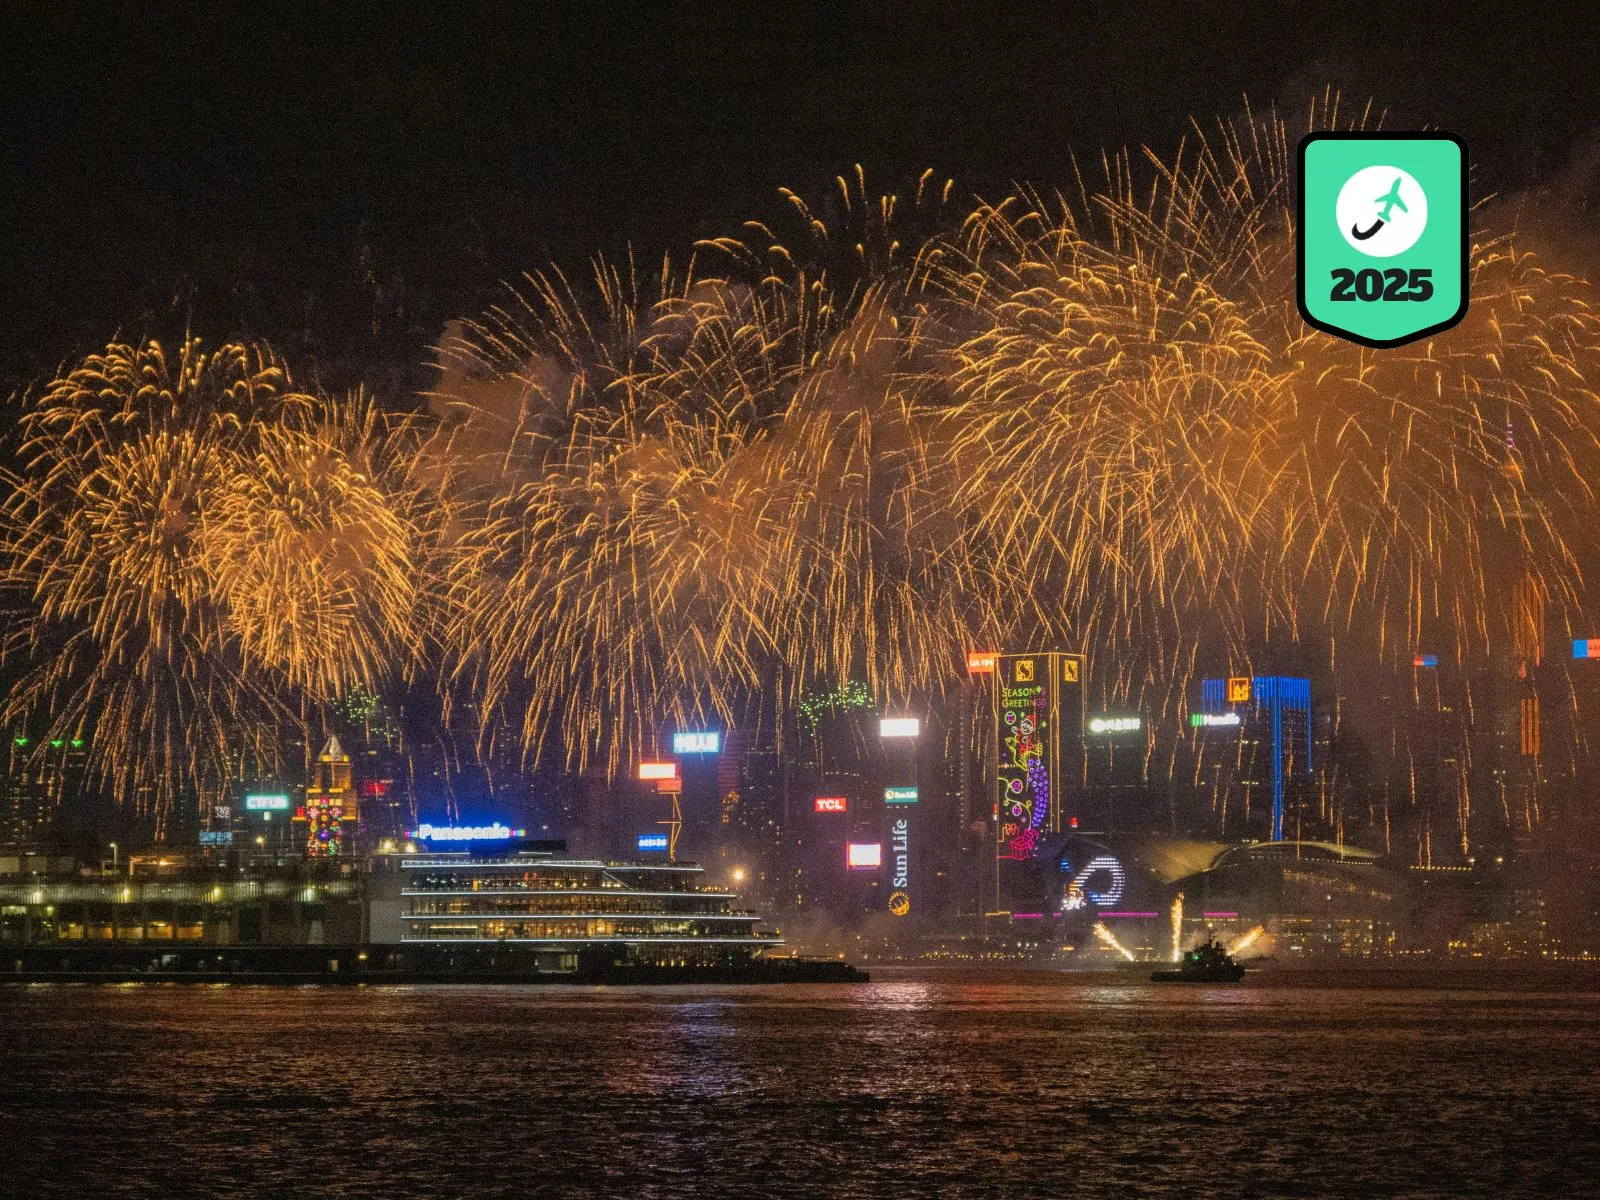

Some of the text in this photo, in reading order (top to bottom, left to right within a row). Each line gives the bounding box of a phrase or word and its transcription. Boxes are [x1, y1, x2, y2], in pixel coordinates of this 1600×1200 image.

[817, 800, 843, 810] TCL
[419, 822, 510, 840] Panasonic
[892, 819, 907, 888] Sun Life
